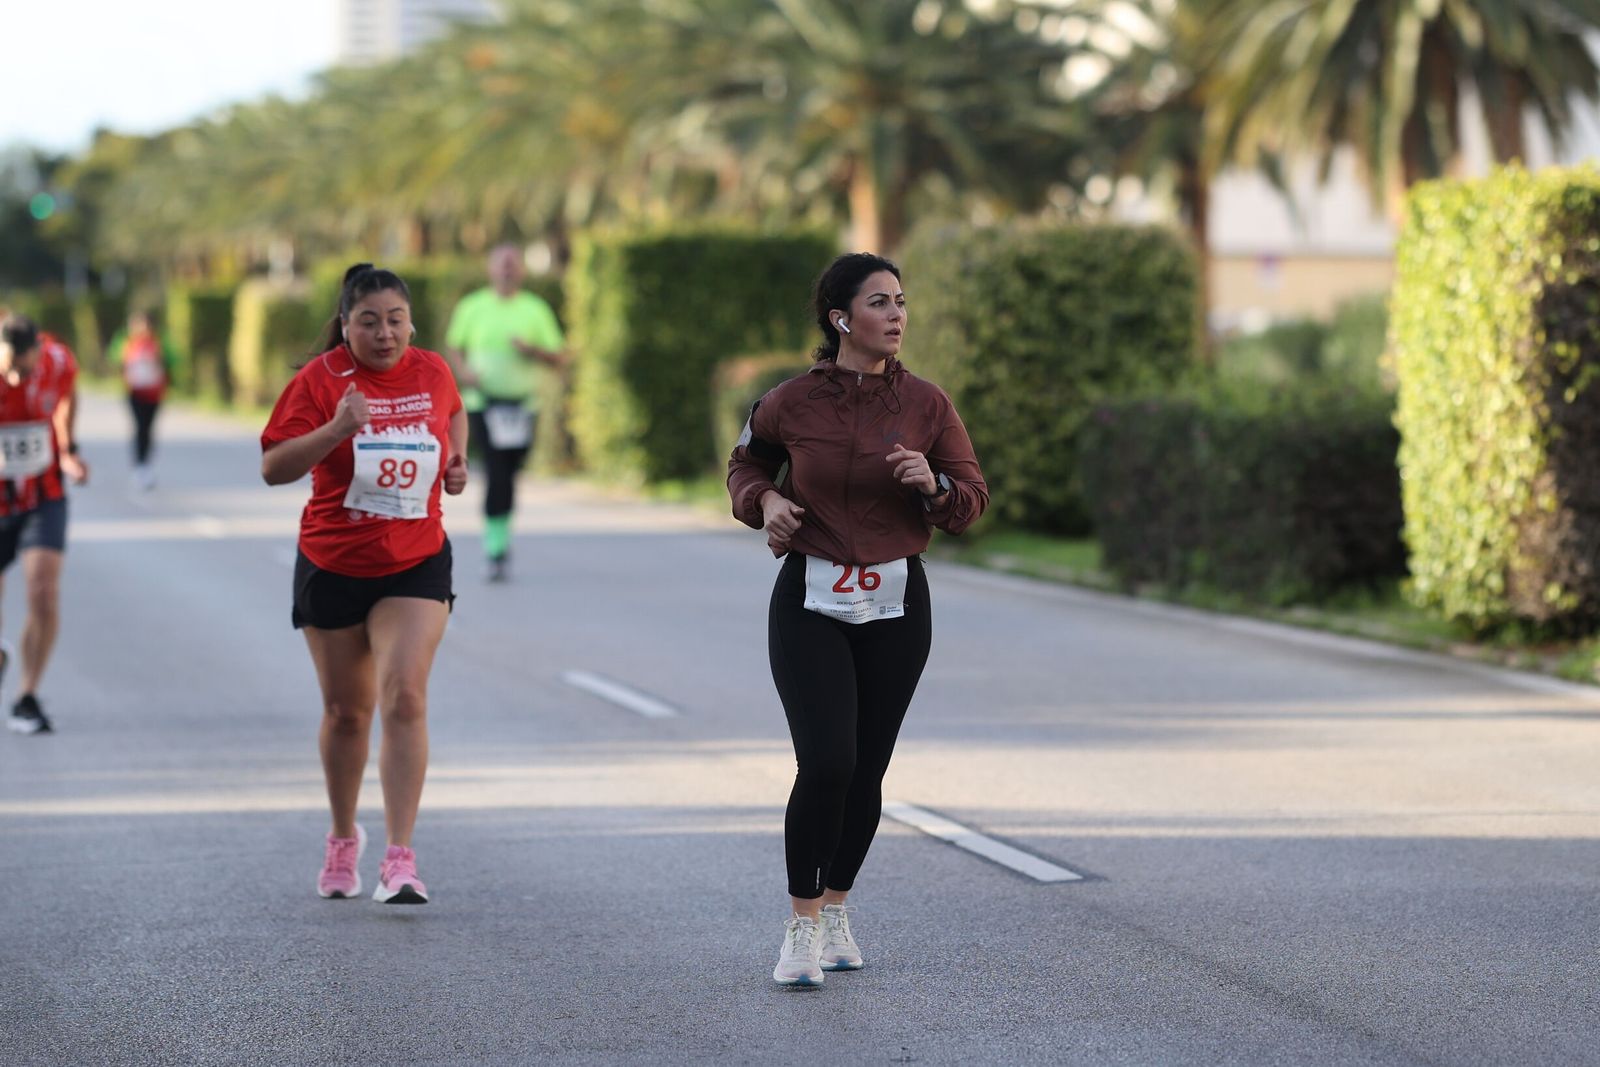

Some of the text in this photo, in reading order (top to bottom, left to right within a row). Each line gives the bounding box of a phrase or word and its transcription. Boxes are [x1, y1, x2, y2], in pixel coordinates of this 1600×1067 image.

[368, 405, 392, 414] DAD
[377, 458, 417, 489] 89
[832, 561, 881, 593] 26
